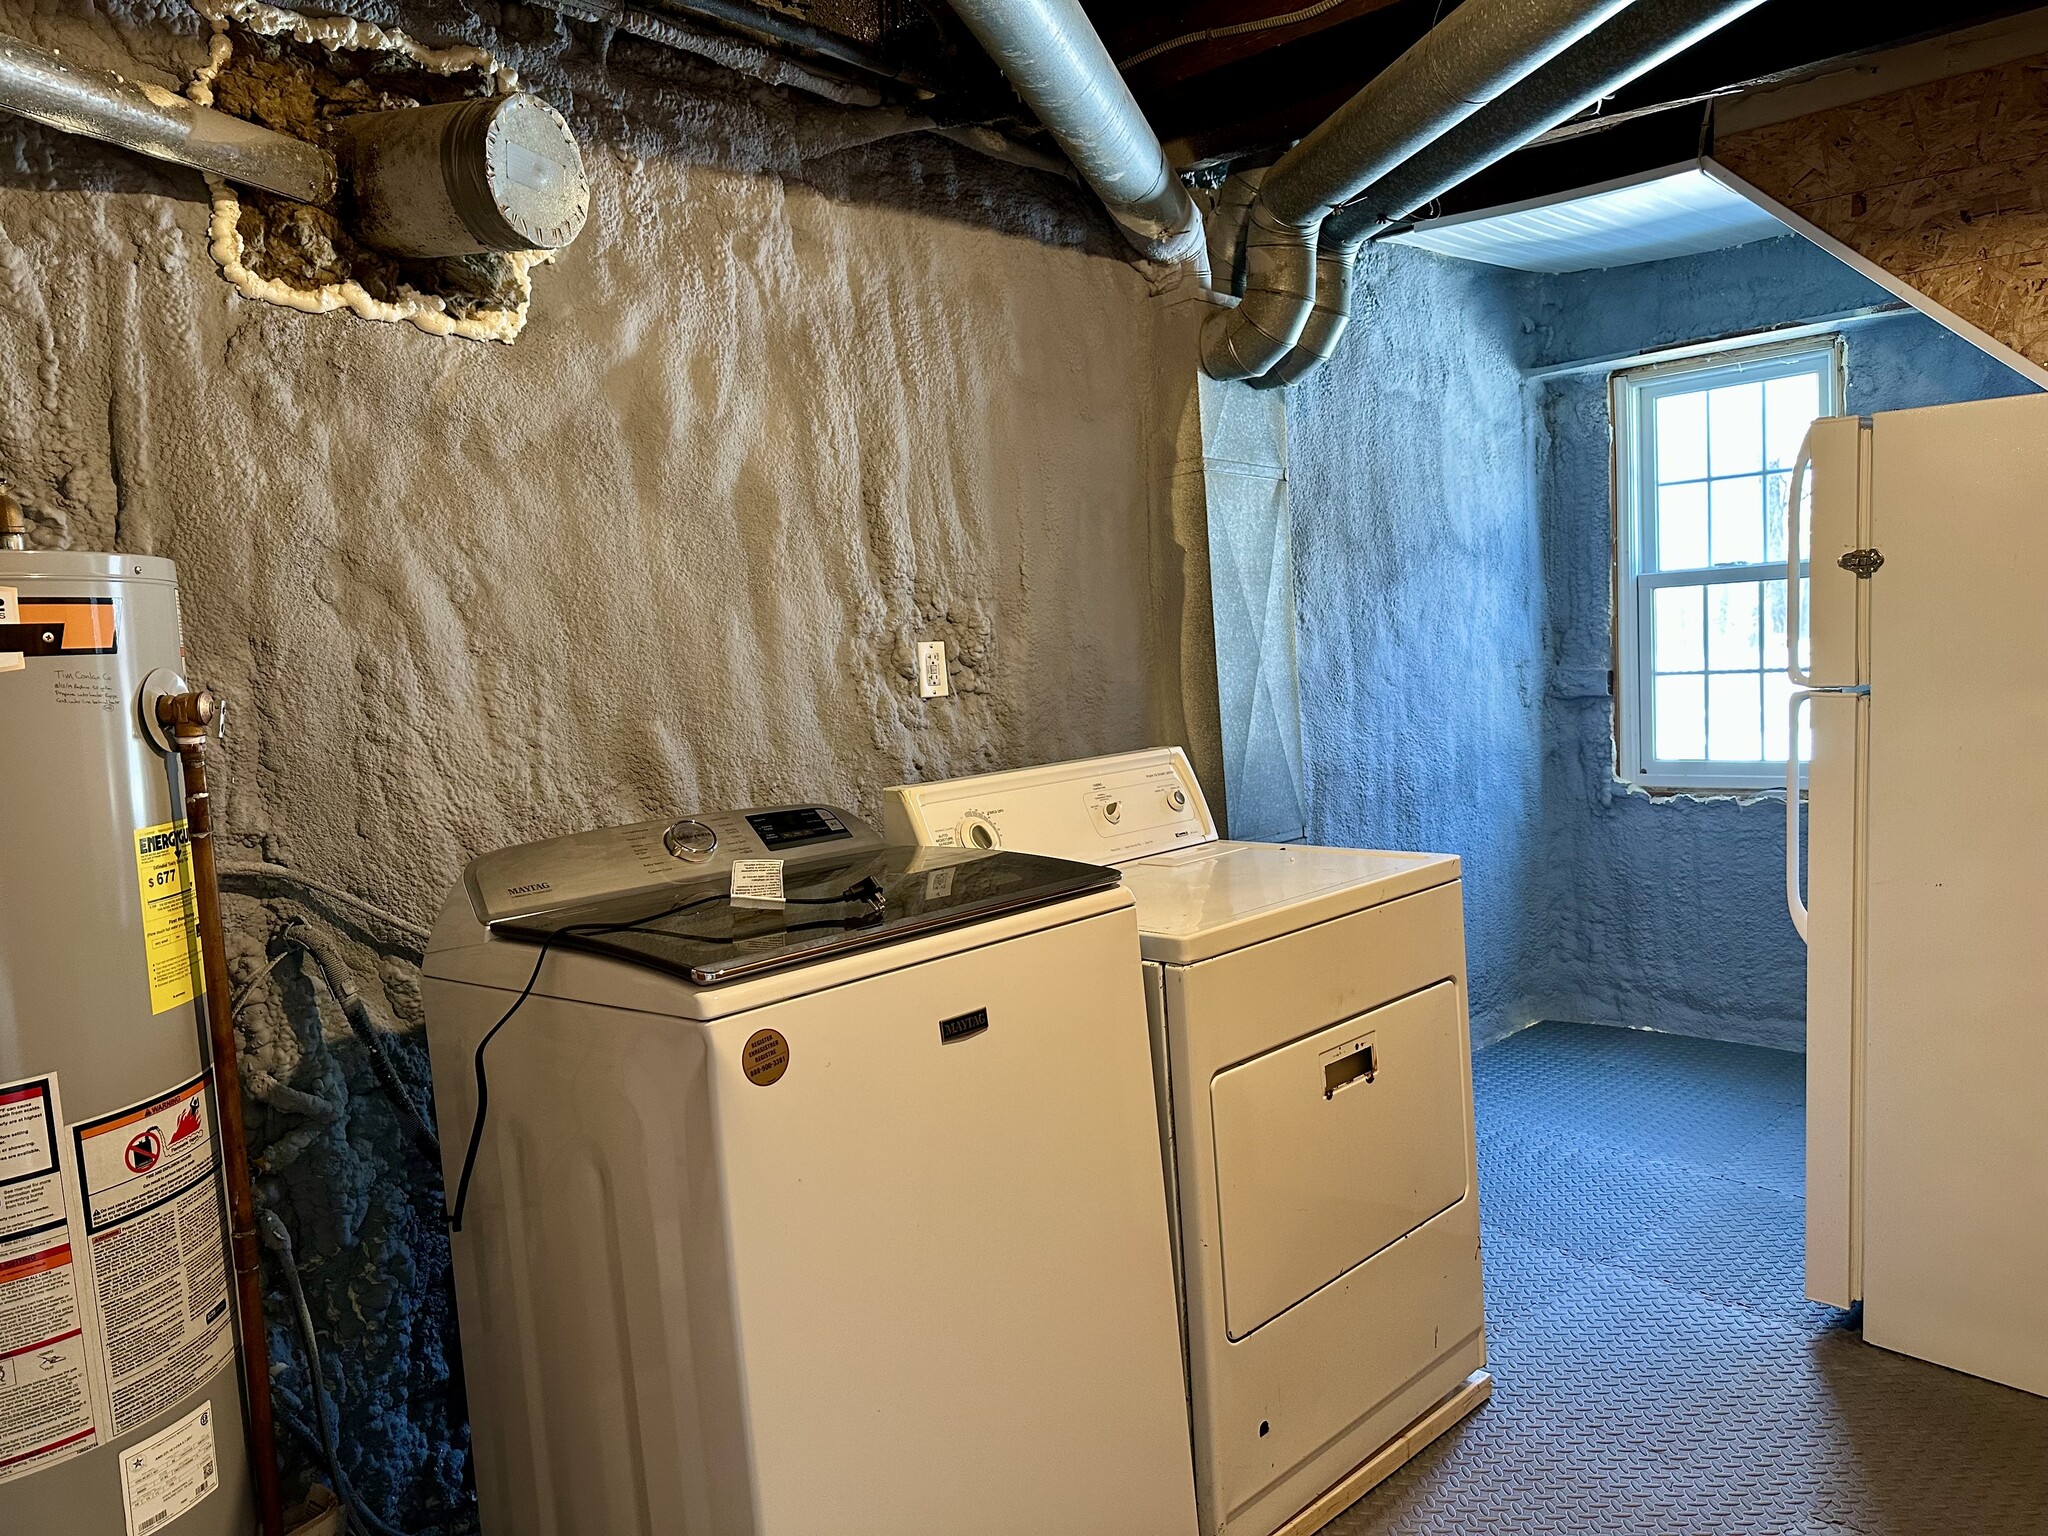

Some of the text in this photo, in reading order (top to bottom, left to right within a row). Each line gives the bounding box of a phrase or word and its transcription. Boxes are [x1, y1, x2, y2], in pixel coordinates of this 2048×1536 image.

[54, 670, 74, 680] Tim
[139, 827, 191, 855] ENERGYGU
[148, 869, 175, 889] $ 677
[507, 881, 551, 896] MAYTAG
[944, 1013, 986, 1036] MAYTAG
[751, 1034, 773, 1048] REGISTER
[152, 1094, 181, 1115] WARNING
